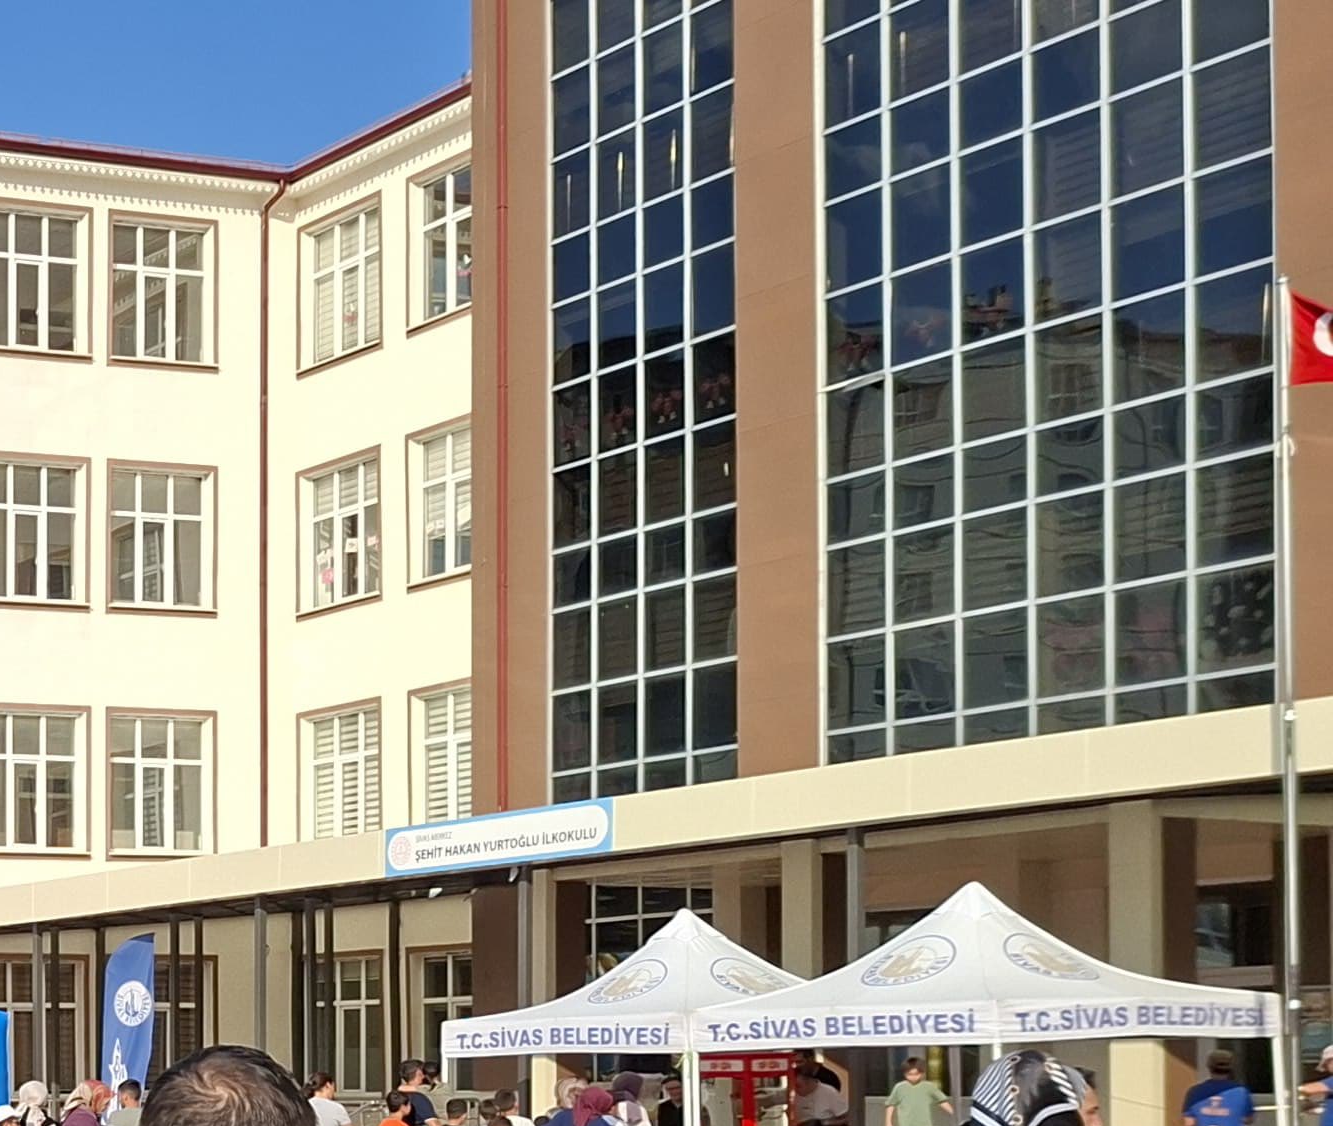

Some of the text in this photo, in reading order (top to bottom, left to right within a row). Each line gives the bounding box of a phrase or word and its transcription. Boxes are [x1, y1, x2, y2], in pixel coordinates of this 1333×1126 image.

[415, 827, 597, 863] ŞEHİT HAKAN YURTOĞLU İLKOKULU
[825, 1008, 975, 1036] BELEDİYESİ
[1136, 1002, 1266, 1027] BELEDİYESİ
[550, 1022, 670, 1046] BELEDİYESİ
